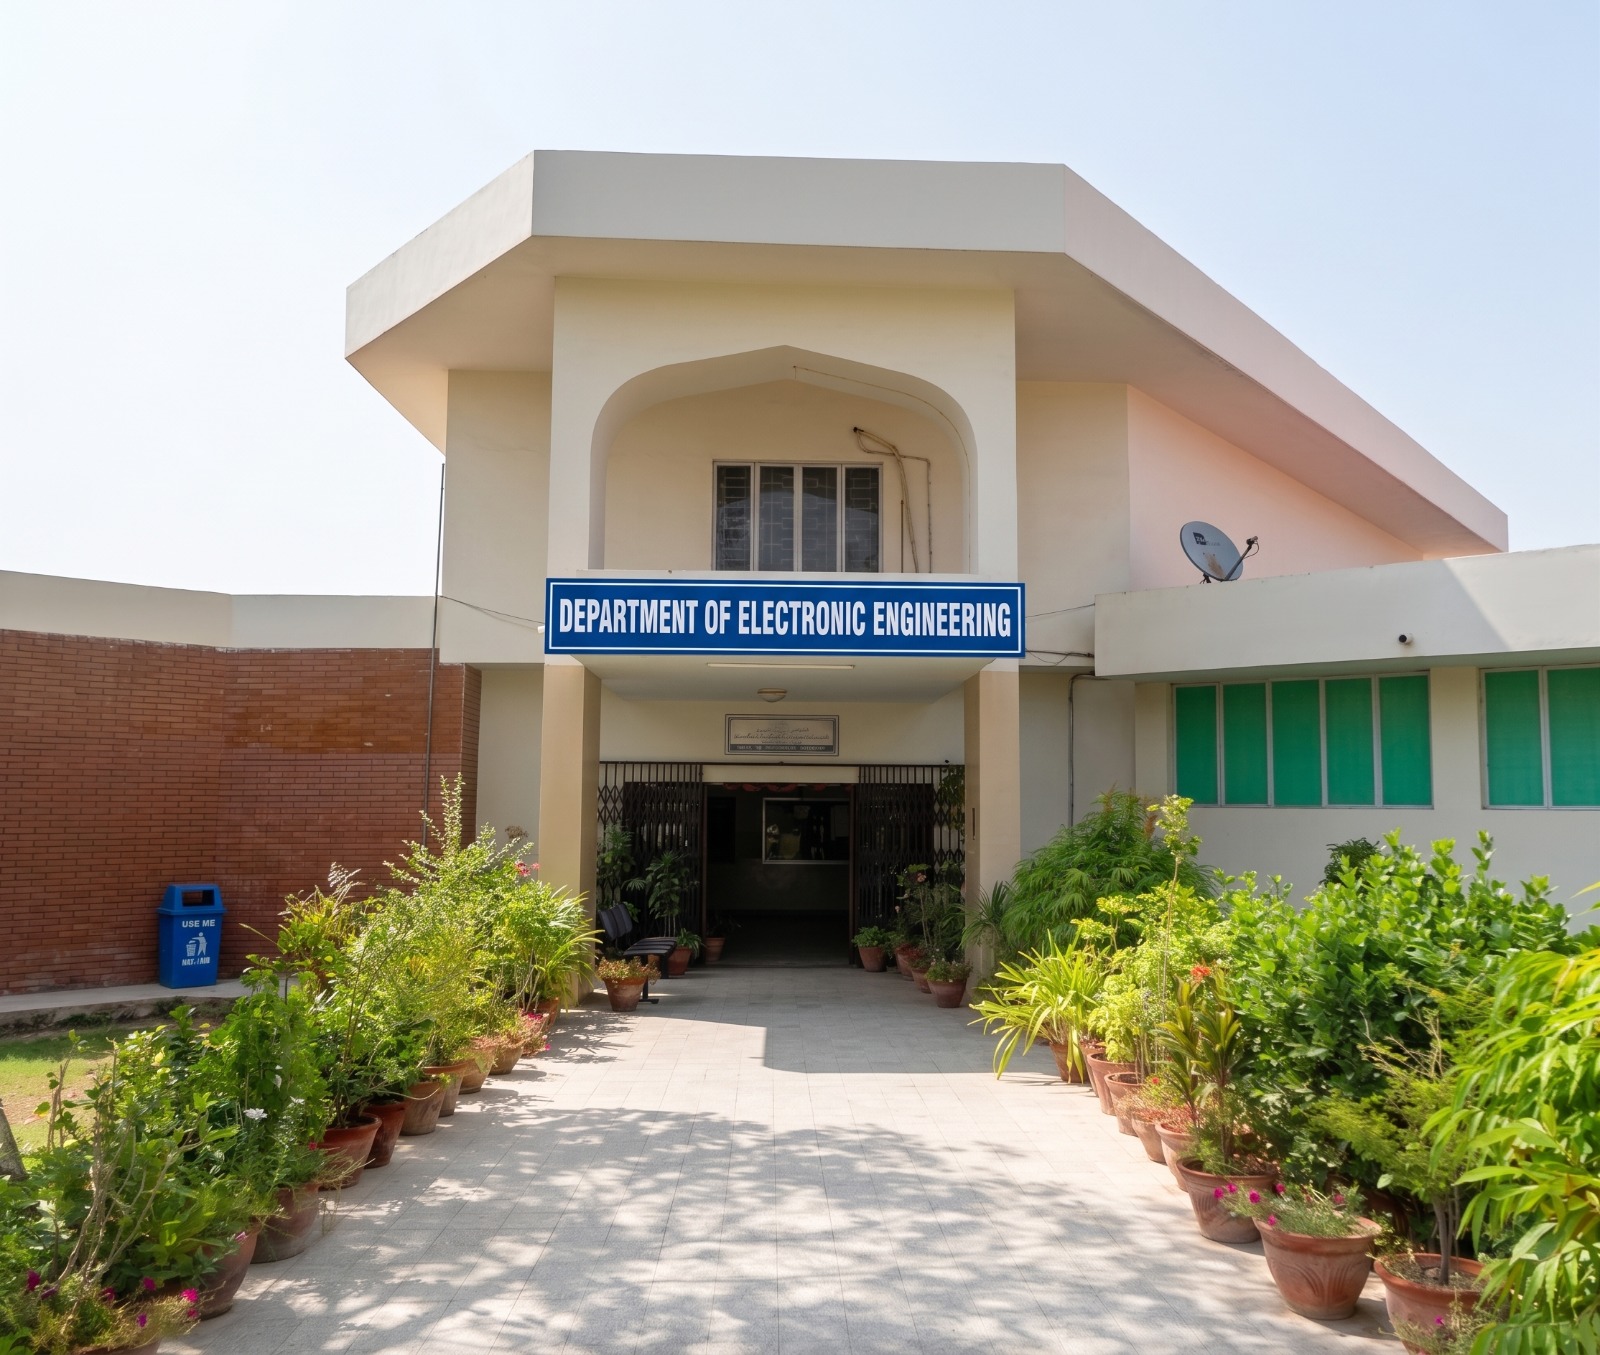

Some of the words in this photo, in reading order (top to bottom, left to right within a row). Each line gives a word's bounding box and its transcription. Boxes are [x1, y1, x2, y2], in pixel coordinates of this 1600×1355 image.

[559, 598, 699, 634] DEPARTMENT
[704, 600, 731, 635] OF
[738, 600, 866, 637] ELECTRONIC
[873, 601, 1012, 638] ENGINEERING
